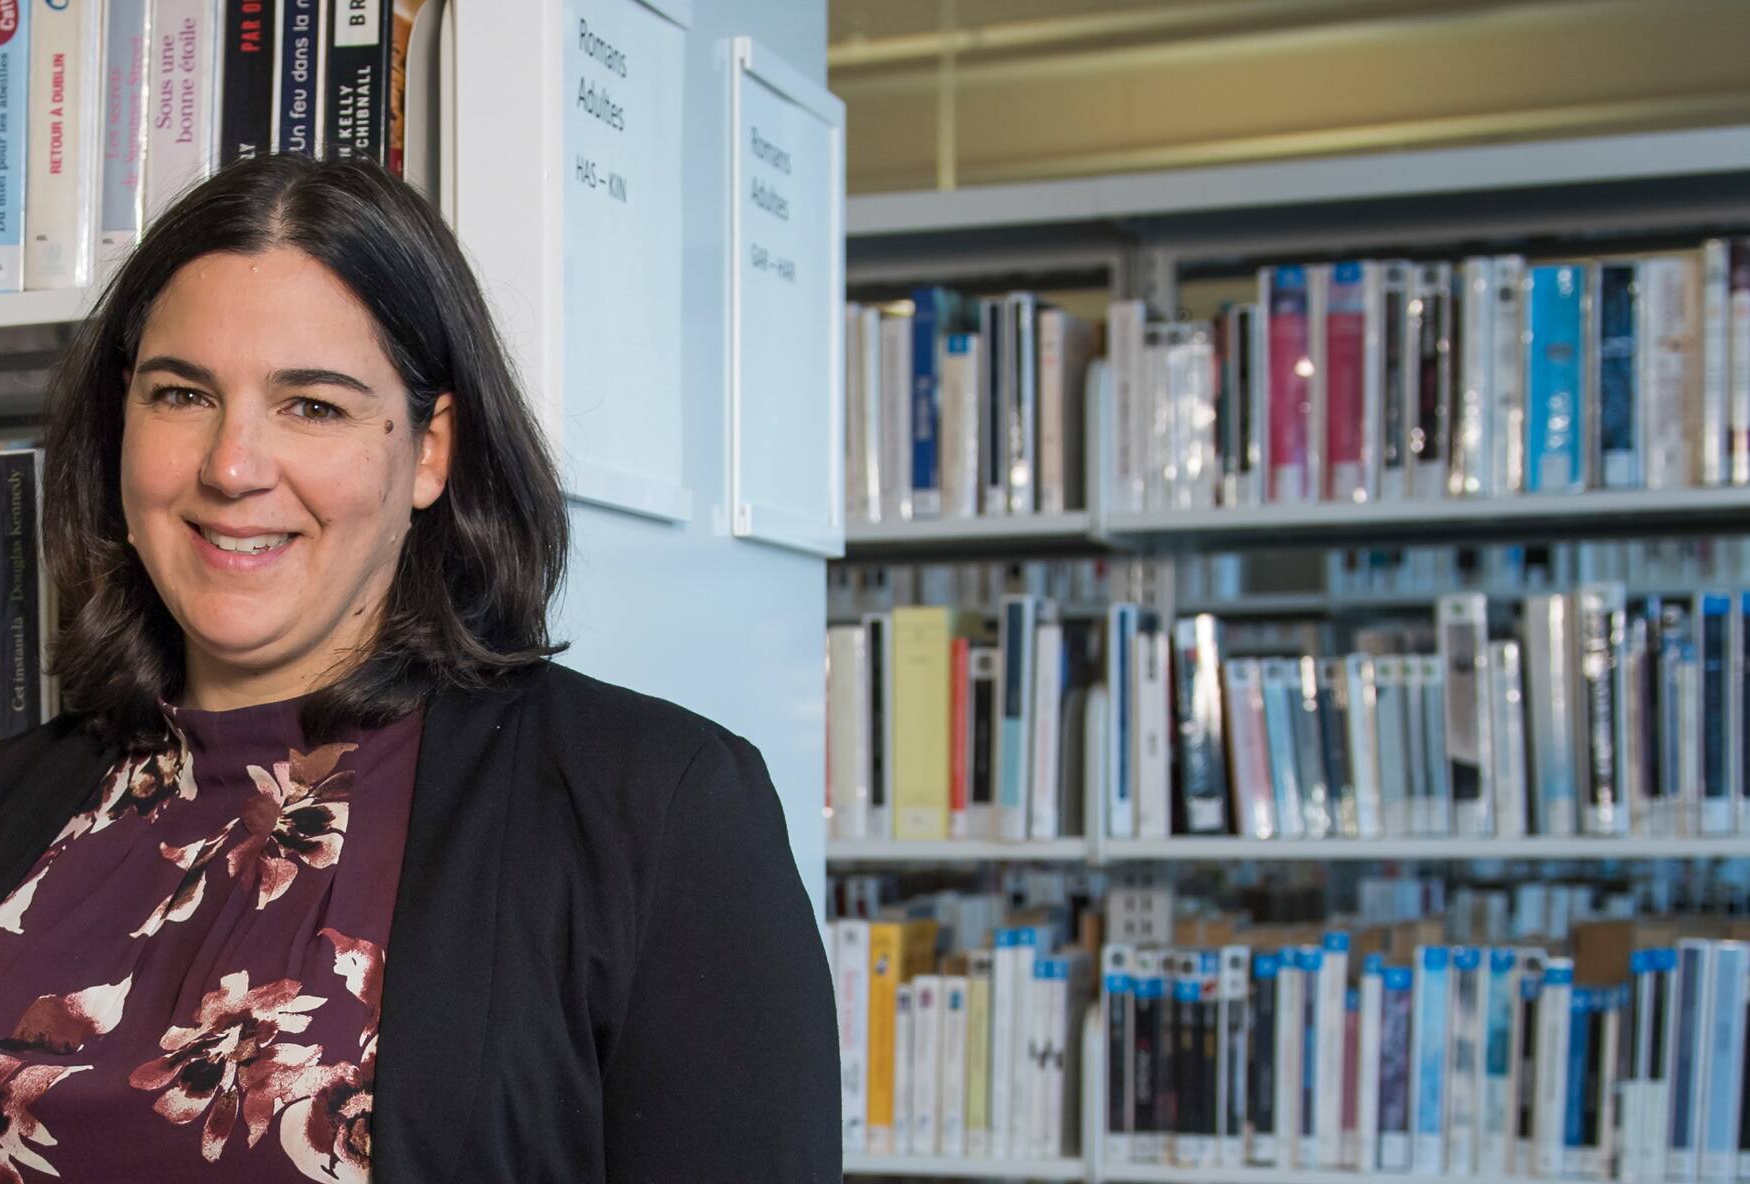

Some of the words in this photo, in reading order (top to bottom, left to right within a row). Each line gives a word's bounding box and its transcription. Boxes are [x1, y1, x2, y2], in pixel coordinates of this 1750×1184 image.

[179, 17, 197, 72] étoile
[241, 20, 261, 52] PAR
[293, 14, 310, 31] la
[160, 34, 175, 73] une
[291, 37, 309, 82] dans
[578, 18, 628, 78] Romans
[52, 53, 65, 102] DUBLIN
[49, 107, 63, 117] À
[156, 80, 174, 130] Sous
[176, 79, 195, 143] bonne
[290, 89, 307, 118] feu
[339, 84, 354, 139] KELLY
[356, 65, 371, 148] CHIBNALL
[576, 76, 625, 132] Adultes
[50, 122, 63, 174] RETOUR
[290, 125, 307, 151] Un
[7, 469, 24, 536] Kennedy
[10, 540, 24, 601] Douglas
[12, 685, 26, 712] Cet
